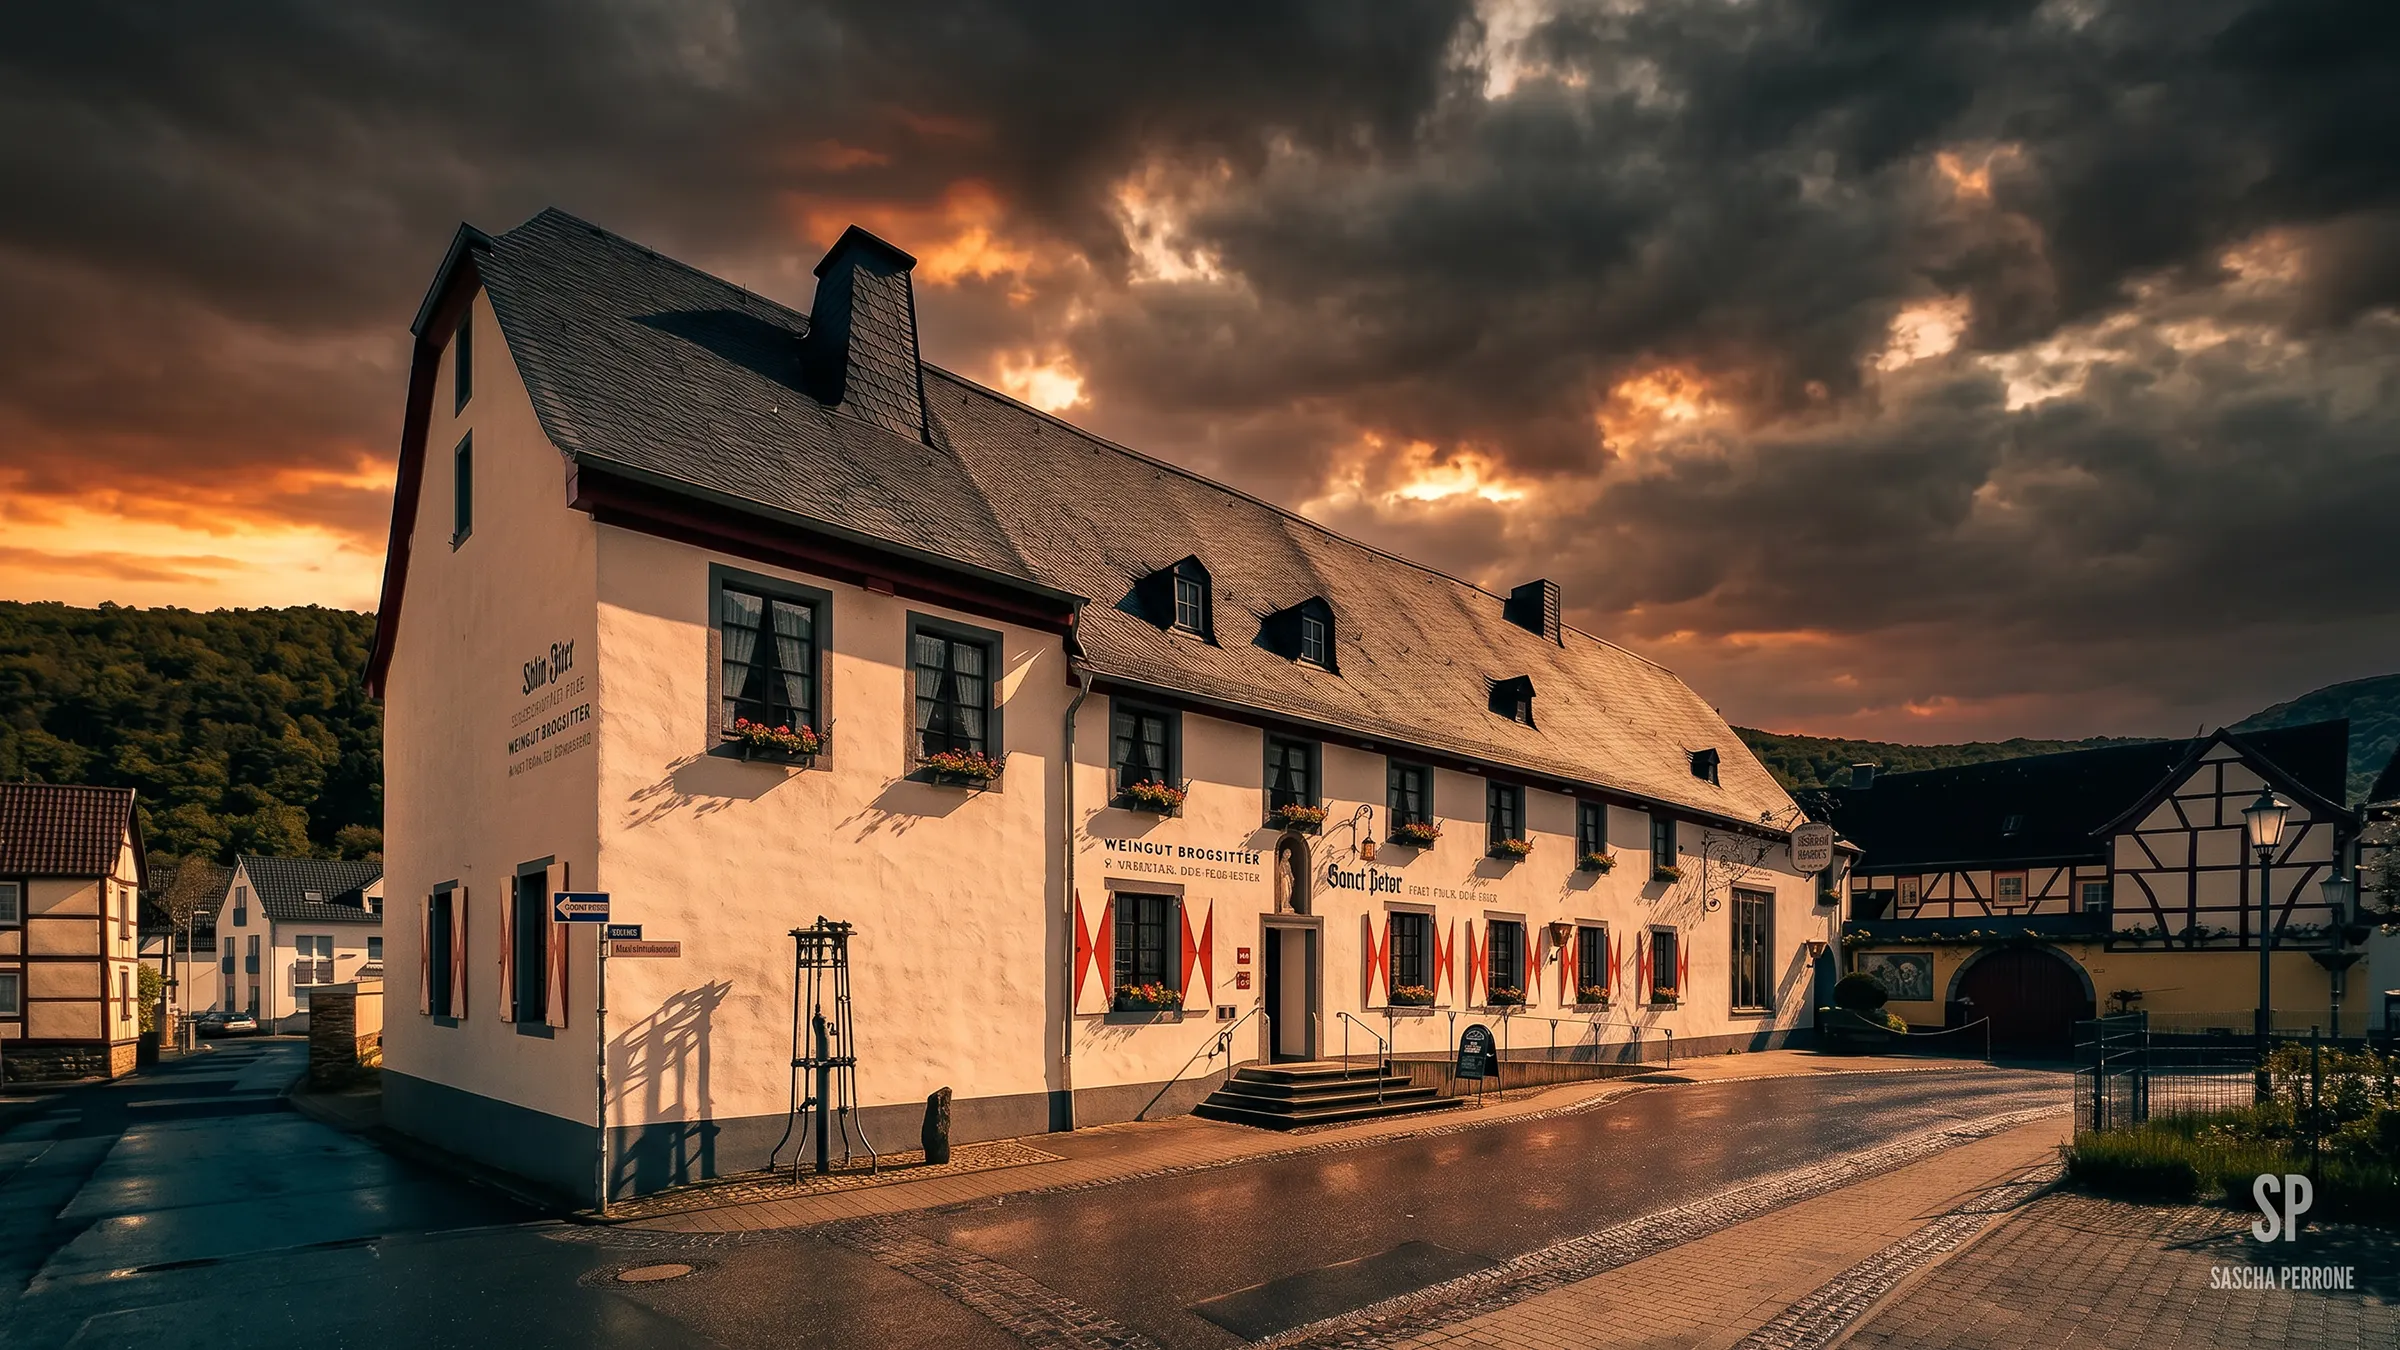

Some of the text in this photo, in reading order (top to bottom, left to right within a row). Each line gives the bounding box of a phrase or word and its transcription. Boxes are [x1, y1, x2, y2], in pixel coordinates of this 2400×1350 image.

[508, 727, 540, 756] WEINGUT
[541, 703, 591, 741] BROGSITTER
[1104, 838, 1260, 866] WEINGUT BROGSITTER
